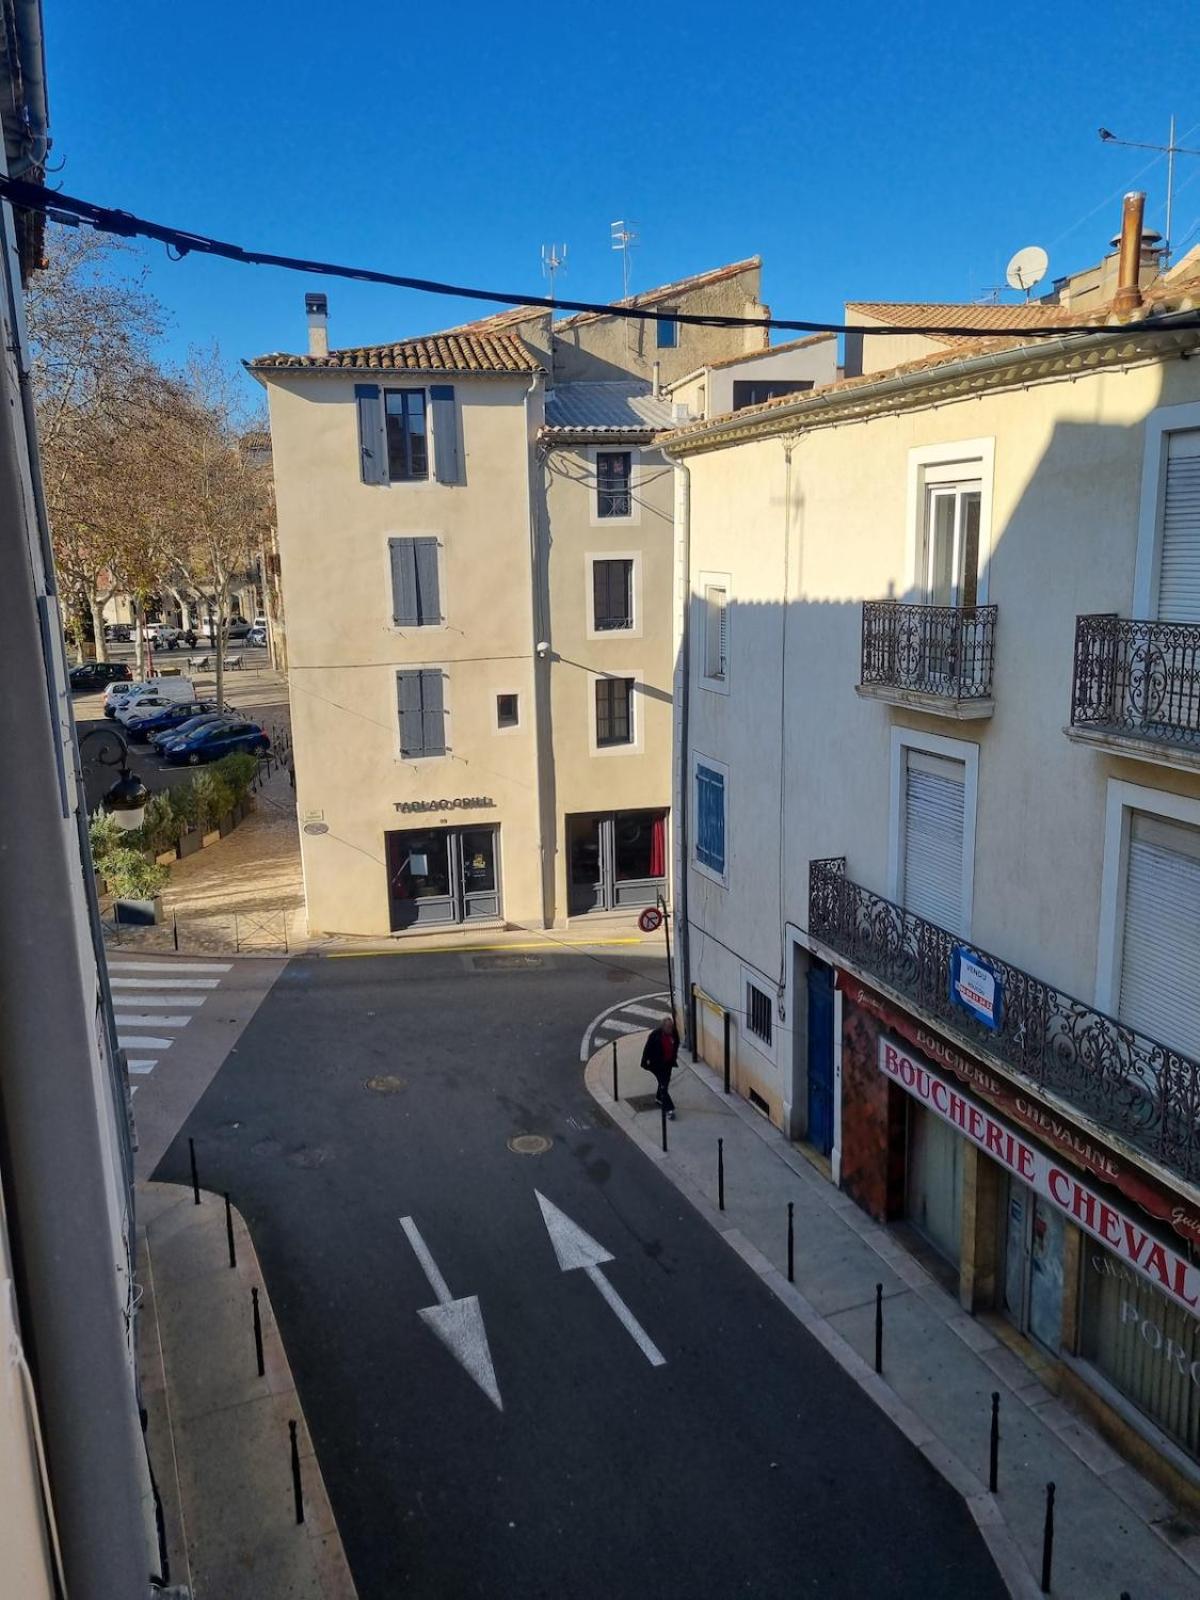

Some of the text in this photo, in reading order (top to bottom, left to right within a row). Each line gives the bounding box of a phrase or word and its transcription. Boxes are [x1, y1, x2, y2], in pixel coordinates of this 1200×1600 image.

[884, 1043, 1036, 1182] BOUCHERIE
[1047, 1168, 1199, 1308] CHEVAL
[916, 1030, 1119, 1179] BOUCHERIE CHEVALINE
